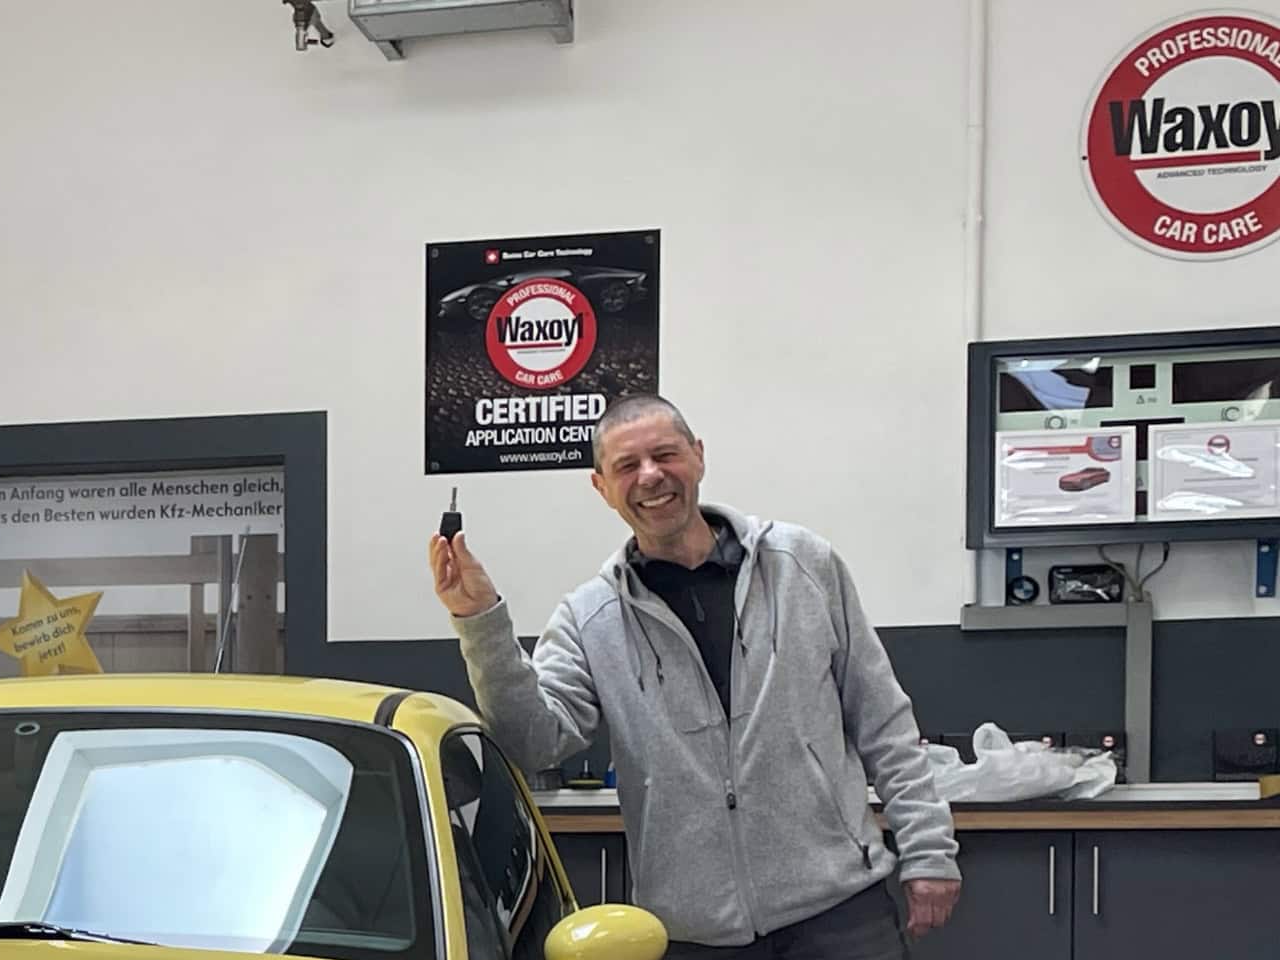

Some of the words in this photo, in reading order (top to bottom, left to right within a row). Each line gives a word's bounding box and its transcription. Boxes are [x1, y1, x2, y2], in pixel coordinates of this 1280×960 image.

[1134, 27, 1280, 76] PROFESSIONA
[1109, 97, 1280, 160] Waxoy
[1154, 215, 1198, 243] CAR
[1203, 211, 1263, 244] CARE
[506, 283, 576, 306] PROFESSIONAL
[495, 312, 584, 346] Waxoyl
[515, 370, 535, 384] CAR
[537, 370, 564, 385] CARE
[475, 393, 607, 425] CERTIFIED
[465, 427, 556, 447] APPLICATION
[559, 425, 596, 442] CENT
[500, 449, 582, 464] www.waxoyl.ch
[10, 485, 64, 503] Anfang
[69, 486, 115, 498] waren
[119, 481, 147, 497] alle
[151, 479, 229, 496] Menschen
[233, 477, 284, 497] gleich,
[11, 508, 40, 524] den
[44, 508, 95, 523] Besten
[99, 504, 156, 520] wurden
[160, 500, 282, 519] Kfz-Mechaniker
[52, 623, 75, 638] dich
